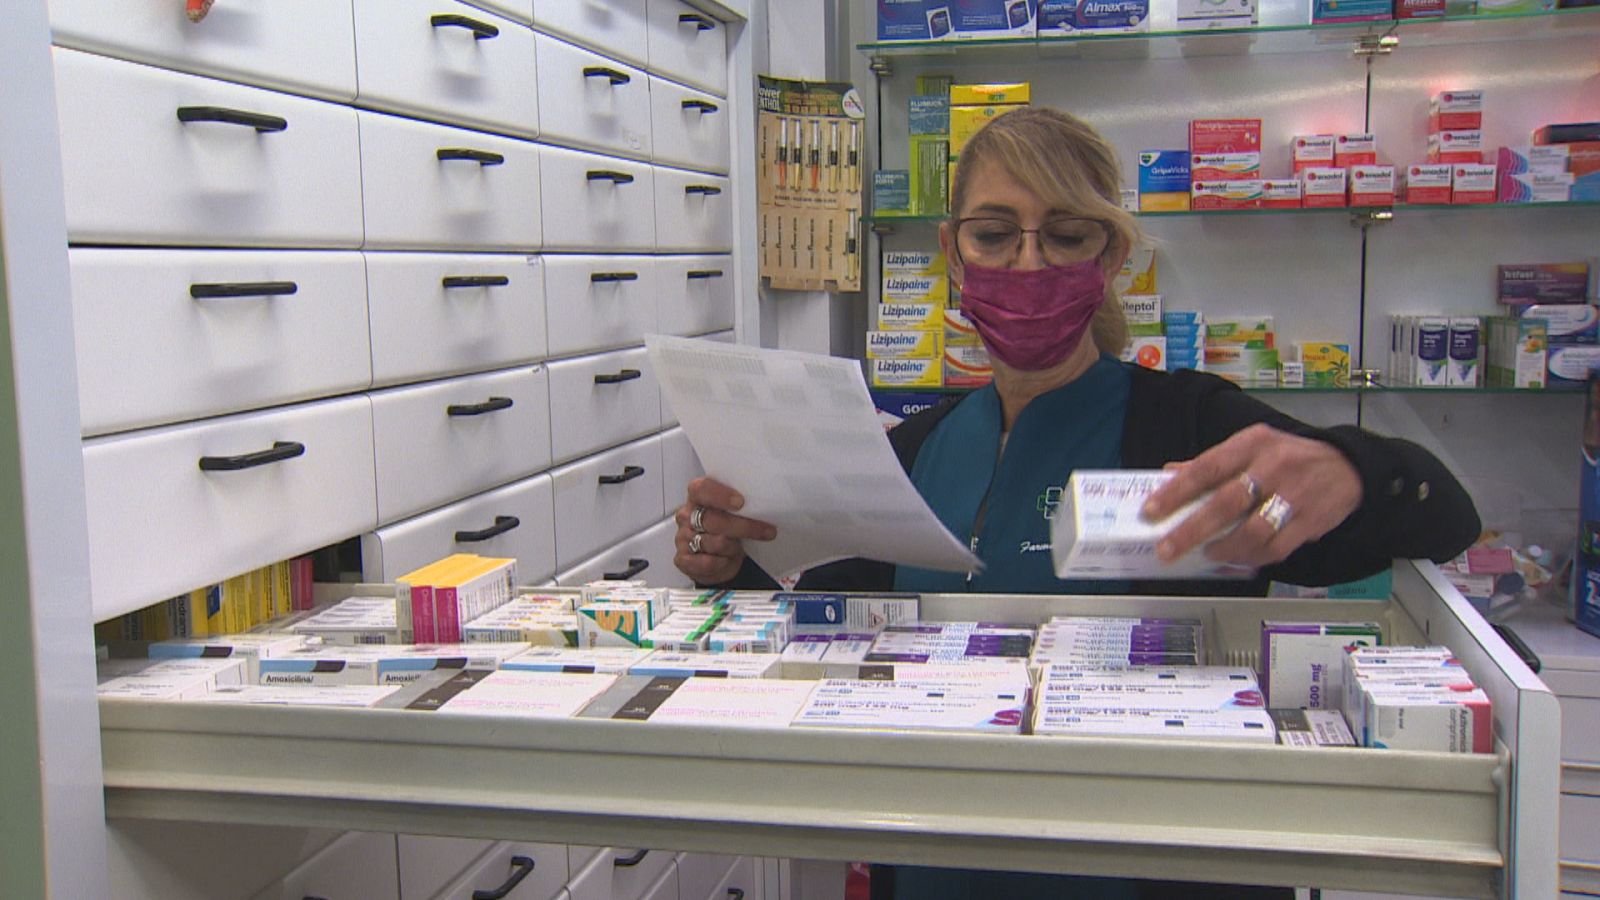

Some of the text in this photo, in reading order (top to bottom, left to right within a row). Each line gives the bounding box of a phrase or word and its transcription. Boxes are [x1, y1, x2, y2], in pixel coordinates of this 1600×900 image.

[1084, 2, 1121, 14] Almax
[886, 254, 930, 266] Lizipaina
[886, 278, 930, 291] Lizipaina
[882, 305, 926, 317] Lizipaina
[870, 334, 916, 346] Lizipaina
[878, 360, 923, 373] Lizipaina
[266, 674, 314, 684] Amoxicilina/
[386, 674, 421, 683] Amoxic
[1310, 663, 1322, 708] 500 mg
